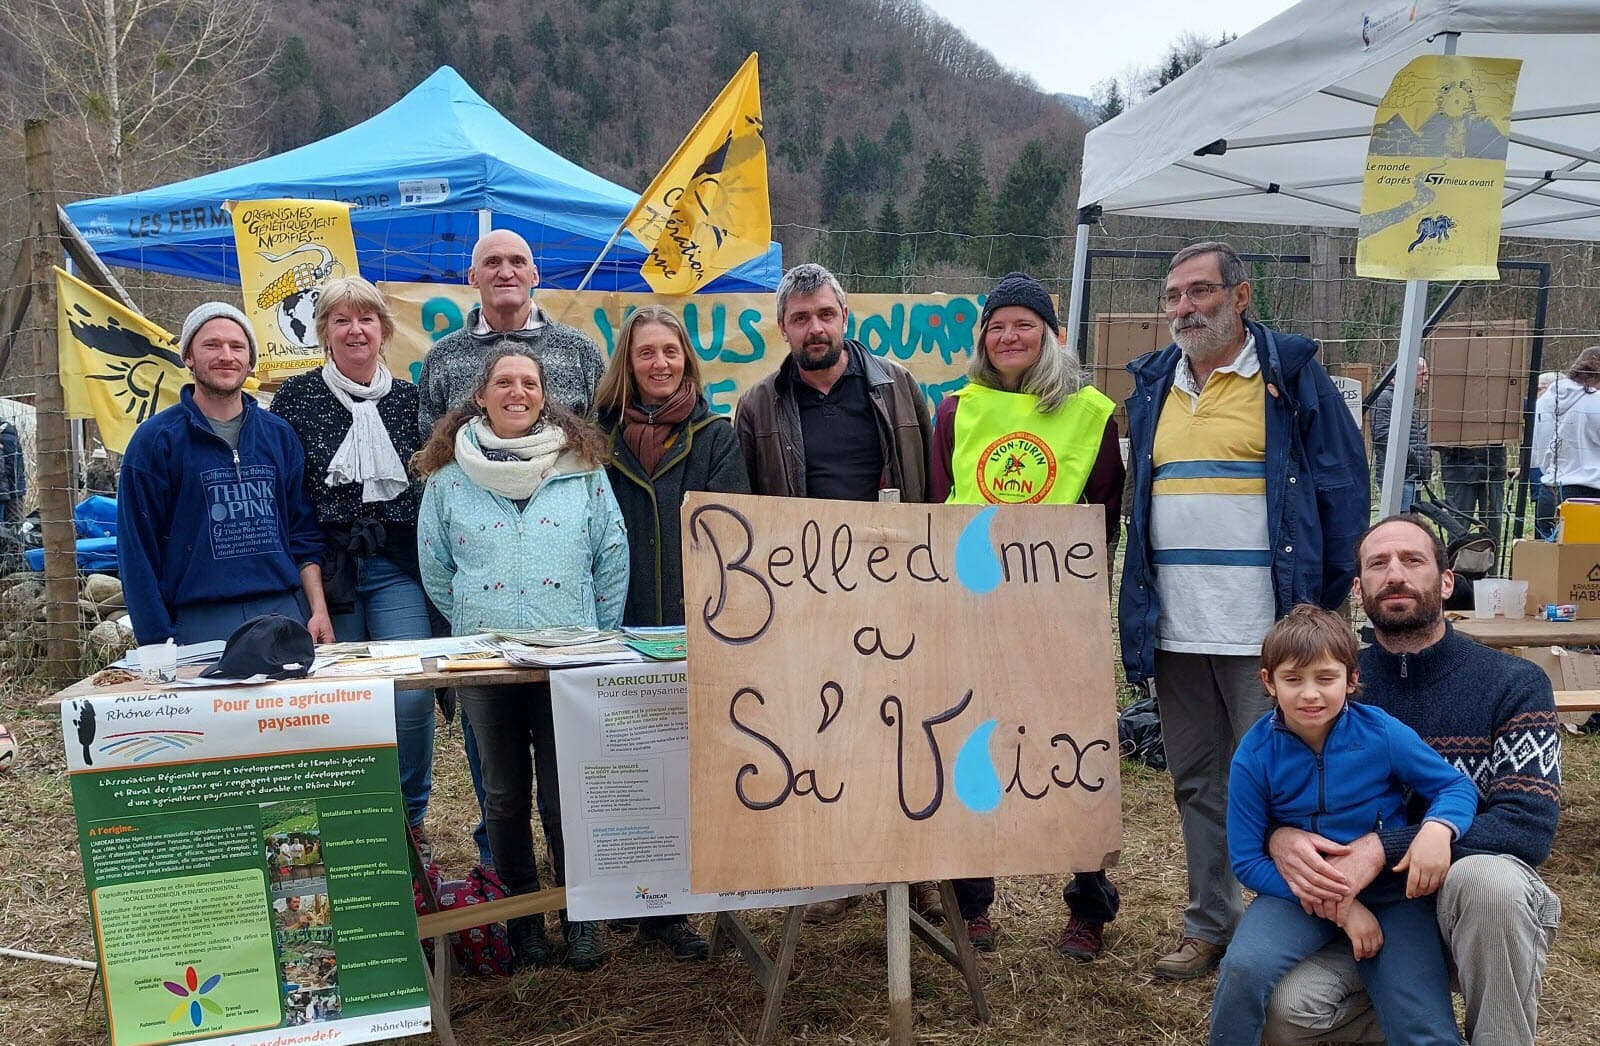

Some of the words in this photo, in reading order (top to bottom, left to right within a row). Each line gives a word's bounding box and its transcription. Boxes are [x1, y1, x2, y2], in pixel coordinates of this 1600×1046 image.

[1366, 162, 1376, 171] Le
[1377, 162, 1410, 171] monde
[1377, 175, 1412, 185] d'après
[1444, 177, 1467, 186] mieux
[1469, 179, 1494, 187] avant
[127, 213, 162, 238] LES
[168, 206, 233, 232] FERM
[242, 206, 314, 224] ORGANISMES
[593, 302, 766, 363] VUS
[990, 440, 1046, 465] LYON-TURIN
[208, 480, 275, 502] THINK
[228, 499, 275, 519] PINK
[854, 626, 915, 660] a
[597, 673, 687, 687] L'AGRICULTUR
[214, 698, 250, 713] Pour
[255, 697, 283, 709] une
[289, 688, 372, 709] agriculture
[597, 690, 619, 698] Pour
[622, 688, 638, 696] des
[106, 709, 153, 721] Rhône
[155, 705, 192, 721] Alpes
[258, 713, 330, 733] paysanne
[100, 774, 155, 787] L'Association
[158, 770, 199, 786] Régionale
[202, 769, 221, 778] pour
[224, 767, 231, 776] le
[233, 762, 295, 775] Développement
[298, 760, 309, 768] de
[310, 758, 340, 769] l'Emploi
[342, 755, 376, 768] Agricole
[113, 790, 123, 798] et
[126, 787, 151, 797] Rural
[154, 785, 169, 794] des
[172, 783, 207, 794] paysans
[210, 780, 223, 788] qui
[225, 776, 271, 788] s'engagent
[273, 774, 293, 784] pour
[294, 773, 302, 781] le
[304, 768, 365, 781] développement
[127, 799, 150, 807] d'une
[152, 795, 201, 808] agriculture
[204, 790, 243, 801] paysanne
[258, 785, 291, 794] durable
[306, 780, 355, 791] Rhône-Alpes
